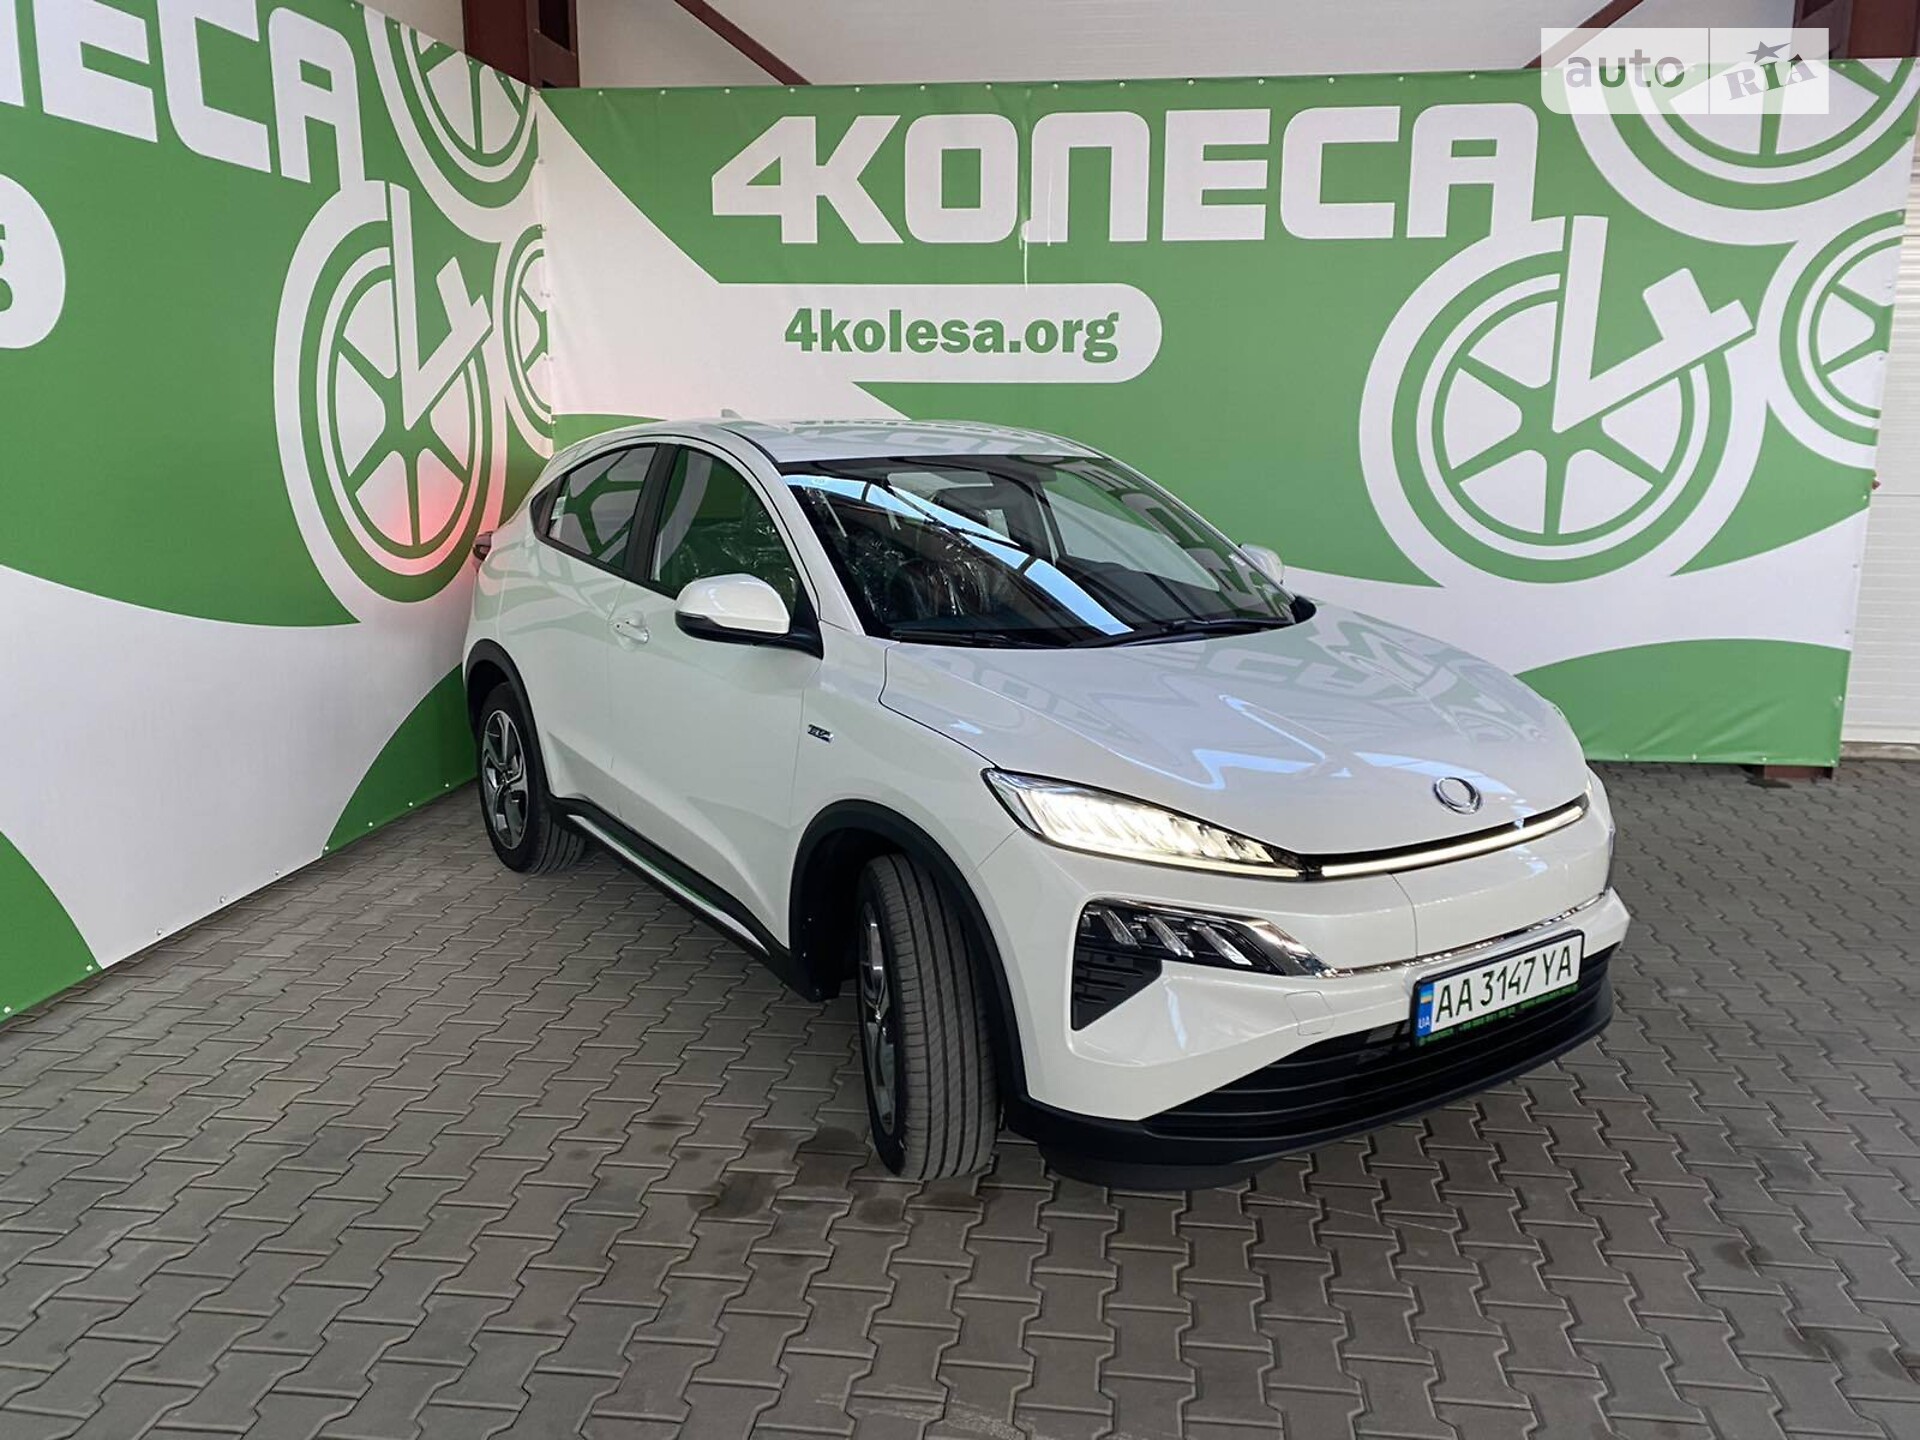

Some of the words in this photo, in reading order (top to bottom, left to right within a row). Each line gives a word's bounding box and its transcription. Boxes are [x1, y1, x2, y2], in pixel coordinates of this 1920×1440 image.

[784, 307, 1120, 364] 4kolesa.org
[1435, 978, 1474, 1023] AA
[1480, 956, 1537, 1006] 3147
[1543, 945, 1572, 985] YA
[1418, 1016, 1431, 1029] UA
